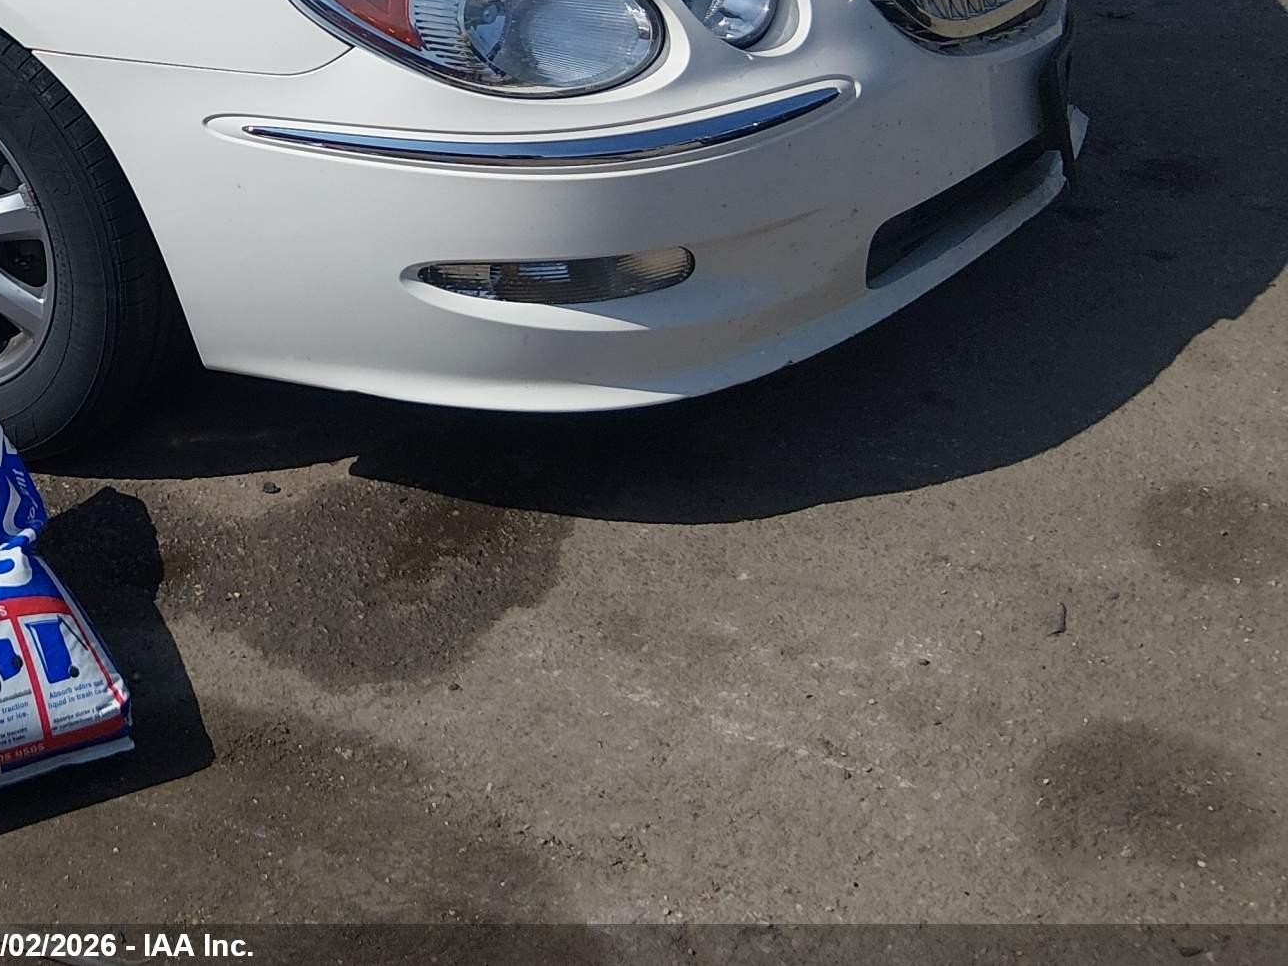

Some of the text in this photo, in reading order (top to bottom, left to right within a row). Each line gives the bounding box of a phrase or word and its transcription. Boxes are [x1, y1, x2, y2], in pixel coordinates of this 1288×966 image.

[49, 687, 72, 699] Absorb
[2, 701, 29, 714] traction
[7, 715, 14, 723] or
[16, 742, 46, 757] USOS
